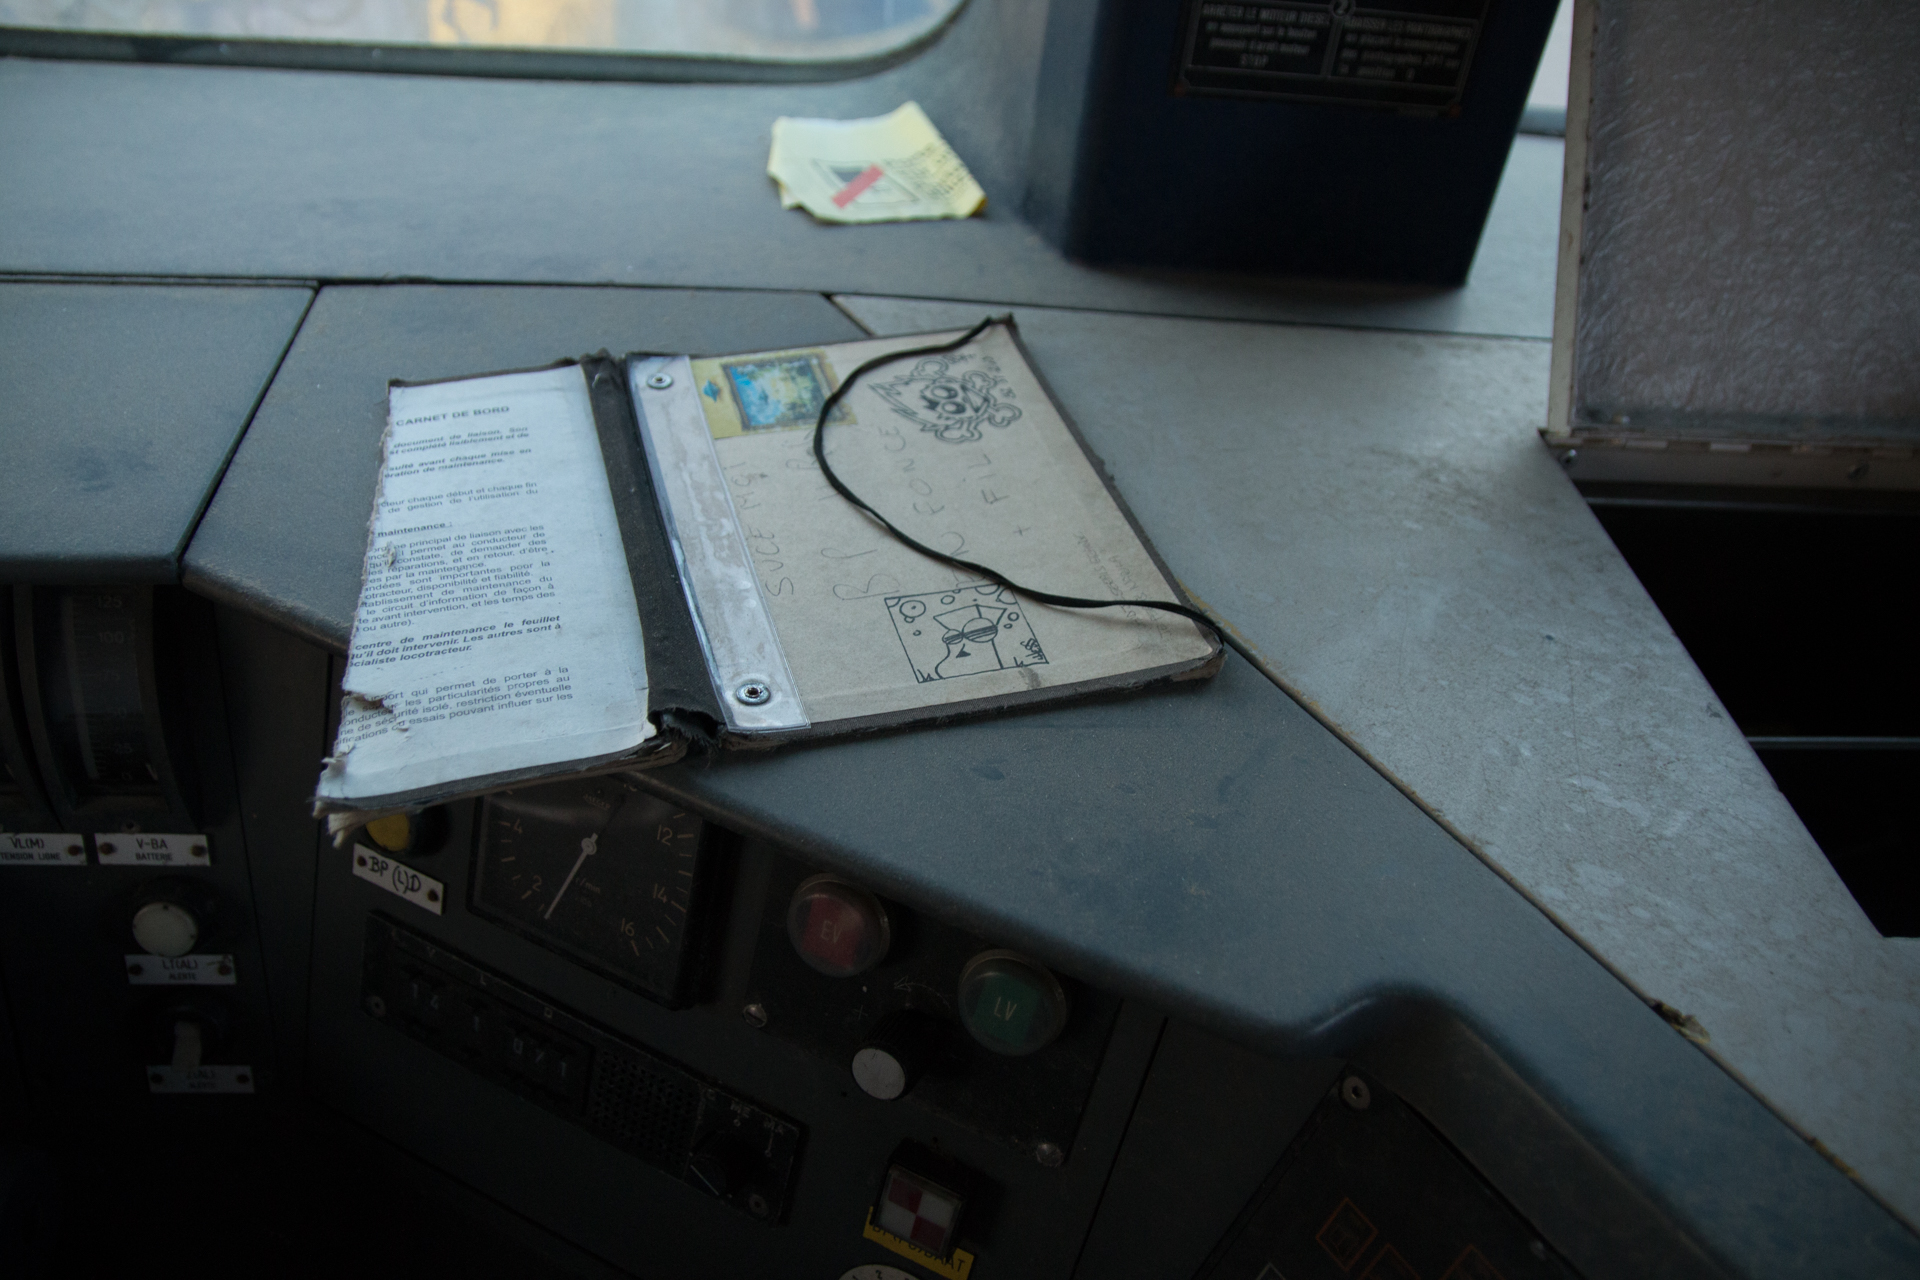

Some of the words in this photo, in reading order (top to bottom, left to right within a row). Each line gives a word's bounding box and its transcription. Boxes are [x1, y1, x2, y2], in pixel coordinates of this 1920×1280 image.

[395, 412, 447, 426] CARNET
[451, 409, 469, 418] DE
[472, 404, 509, 415] BORD
[387, 506, 400, 514] de
[406, 500, 443, 513] gestion
[448, 497, 462, 505] de
[468, 490, 520, 503] l'utilisation
[525, 487, 538, 495] du
[407, 493, 444, 503] chaque
[445, 487, 473, 498] début
[475, 486, 485, 494] et
[487, 482, 523, 492] chaque
[376, 522, 446, 537] maintenance
[408, 535, 452, 549] principal
[453, 533, 467, 541] de
[468, 529, 502, 539] liaison
[503, 525, 527, 534] avec
[529, 523, 544, 531] les
[396, 552, 443, 564] constate,
[469, 541, 520, 554] demander
[527, 538, 547, 546] des
[409, 543, 446, 556] permet
[452, 541, 465, 549] au
[470, 533, 526, 546] conducteur
[532, 530, 545, 538] de
[387, 559, 448, 573] réparations,
[452, 555, 462, 564] et
[466, 554, 479, 562] en
[483, 550, 514, 559] retour,
[519, 545, 547, 554] d'être
[385, 573, 402, 582] par
[405, 570, 415, 578] la
[417, 561, 487, 576] maintenance.
[409, 575, 432, 585] sont
[439, 566, 502, 581] importantes
[509, 562, 533, 572] pour
[366, 587, 413, 599] otracteur,
[416, 576, 478, 592] disponibilité
[480, 574, 491, 583] et
[494, 569, 533, 581] fiabilité.
[440, 588, 455, 596] de
[462, 578, 531, 593] maintenance
[538, 574, 552, 582] du
[366, 607, 376, 615] le
[381, 601, 413, 612] circuit
[418, 592, 487, 607] d'information
[512, 584, 541, 594] façon
[547, 581, 554, 589] à
[371, 611, 401, 622] avant
[403, 603, 468, 618] intervention,
[470, 600, 481, 608] et
[483, 598, 499, 606] les
[501, 593, 534, 604] temps
[535, 590, 555, 599] des
[354, 639, 392, 650] centre
[399, 636, 414, 644] de
[422, 624, 496, 640] maintenance
[521, 613, 560, 626] feuillet
[362, 624, 376, 632] ou
[379, 618, 414, 629] autre).
[100, 630, 124, 644] 100
[376, 645, 399, 656] doit
[401, 638, 459, 652] intervenir.
[462, 634, 483, 643] Les
[486, 628, 523, 639] autres
[526, 623, 552, 633] sont
[554, 621, 561, 629] à
[399, 645, 472, 660] locotracteur.
[404, 698, 421, 706] les
[427, 685, 500, 704] particularités
[506, 678, 549, 691] propres
[555, 674, 570, 682] au
[410, 687, 428, 697] qui
[435, 679, 475, 694] permet
[482, 677, 496, 685] de
[503, 671, 537, 683] porter
[544, 667, 552, 675] à
[558, 665, 568, 673] la
[358, 722, 372, 732] de
[422, 702, 452, 713] isolé,
[456, 693, 511, 707] restriction
[514, 683, 571, 698] éventuelle
[408, 713, 446, 724] essais
[448, 704, 494, 719] pouvant
[497, 698, 532, 710] influer
[535, 695, 553, 703] sur
[556, 692, 573, 700] les
[512, 818, 523, 835] 4
[656, 824, 674, 846] 12
[10, 837, 45, 849] VL(M)
[136, 838, 168, 850] V-BA
[38, 852, 61, 861] LIGNE
[136, 852, 173, 861] BATTERIE
[368, 856, 389, 876] BP
[531, 875, 543, 893] 2
[653, 882, 669, 904] 14
[620, 917, 635, 937] 16
[820, 919, 845, 944] EV
[993, 996, 1018, 1022] LV
